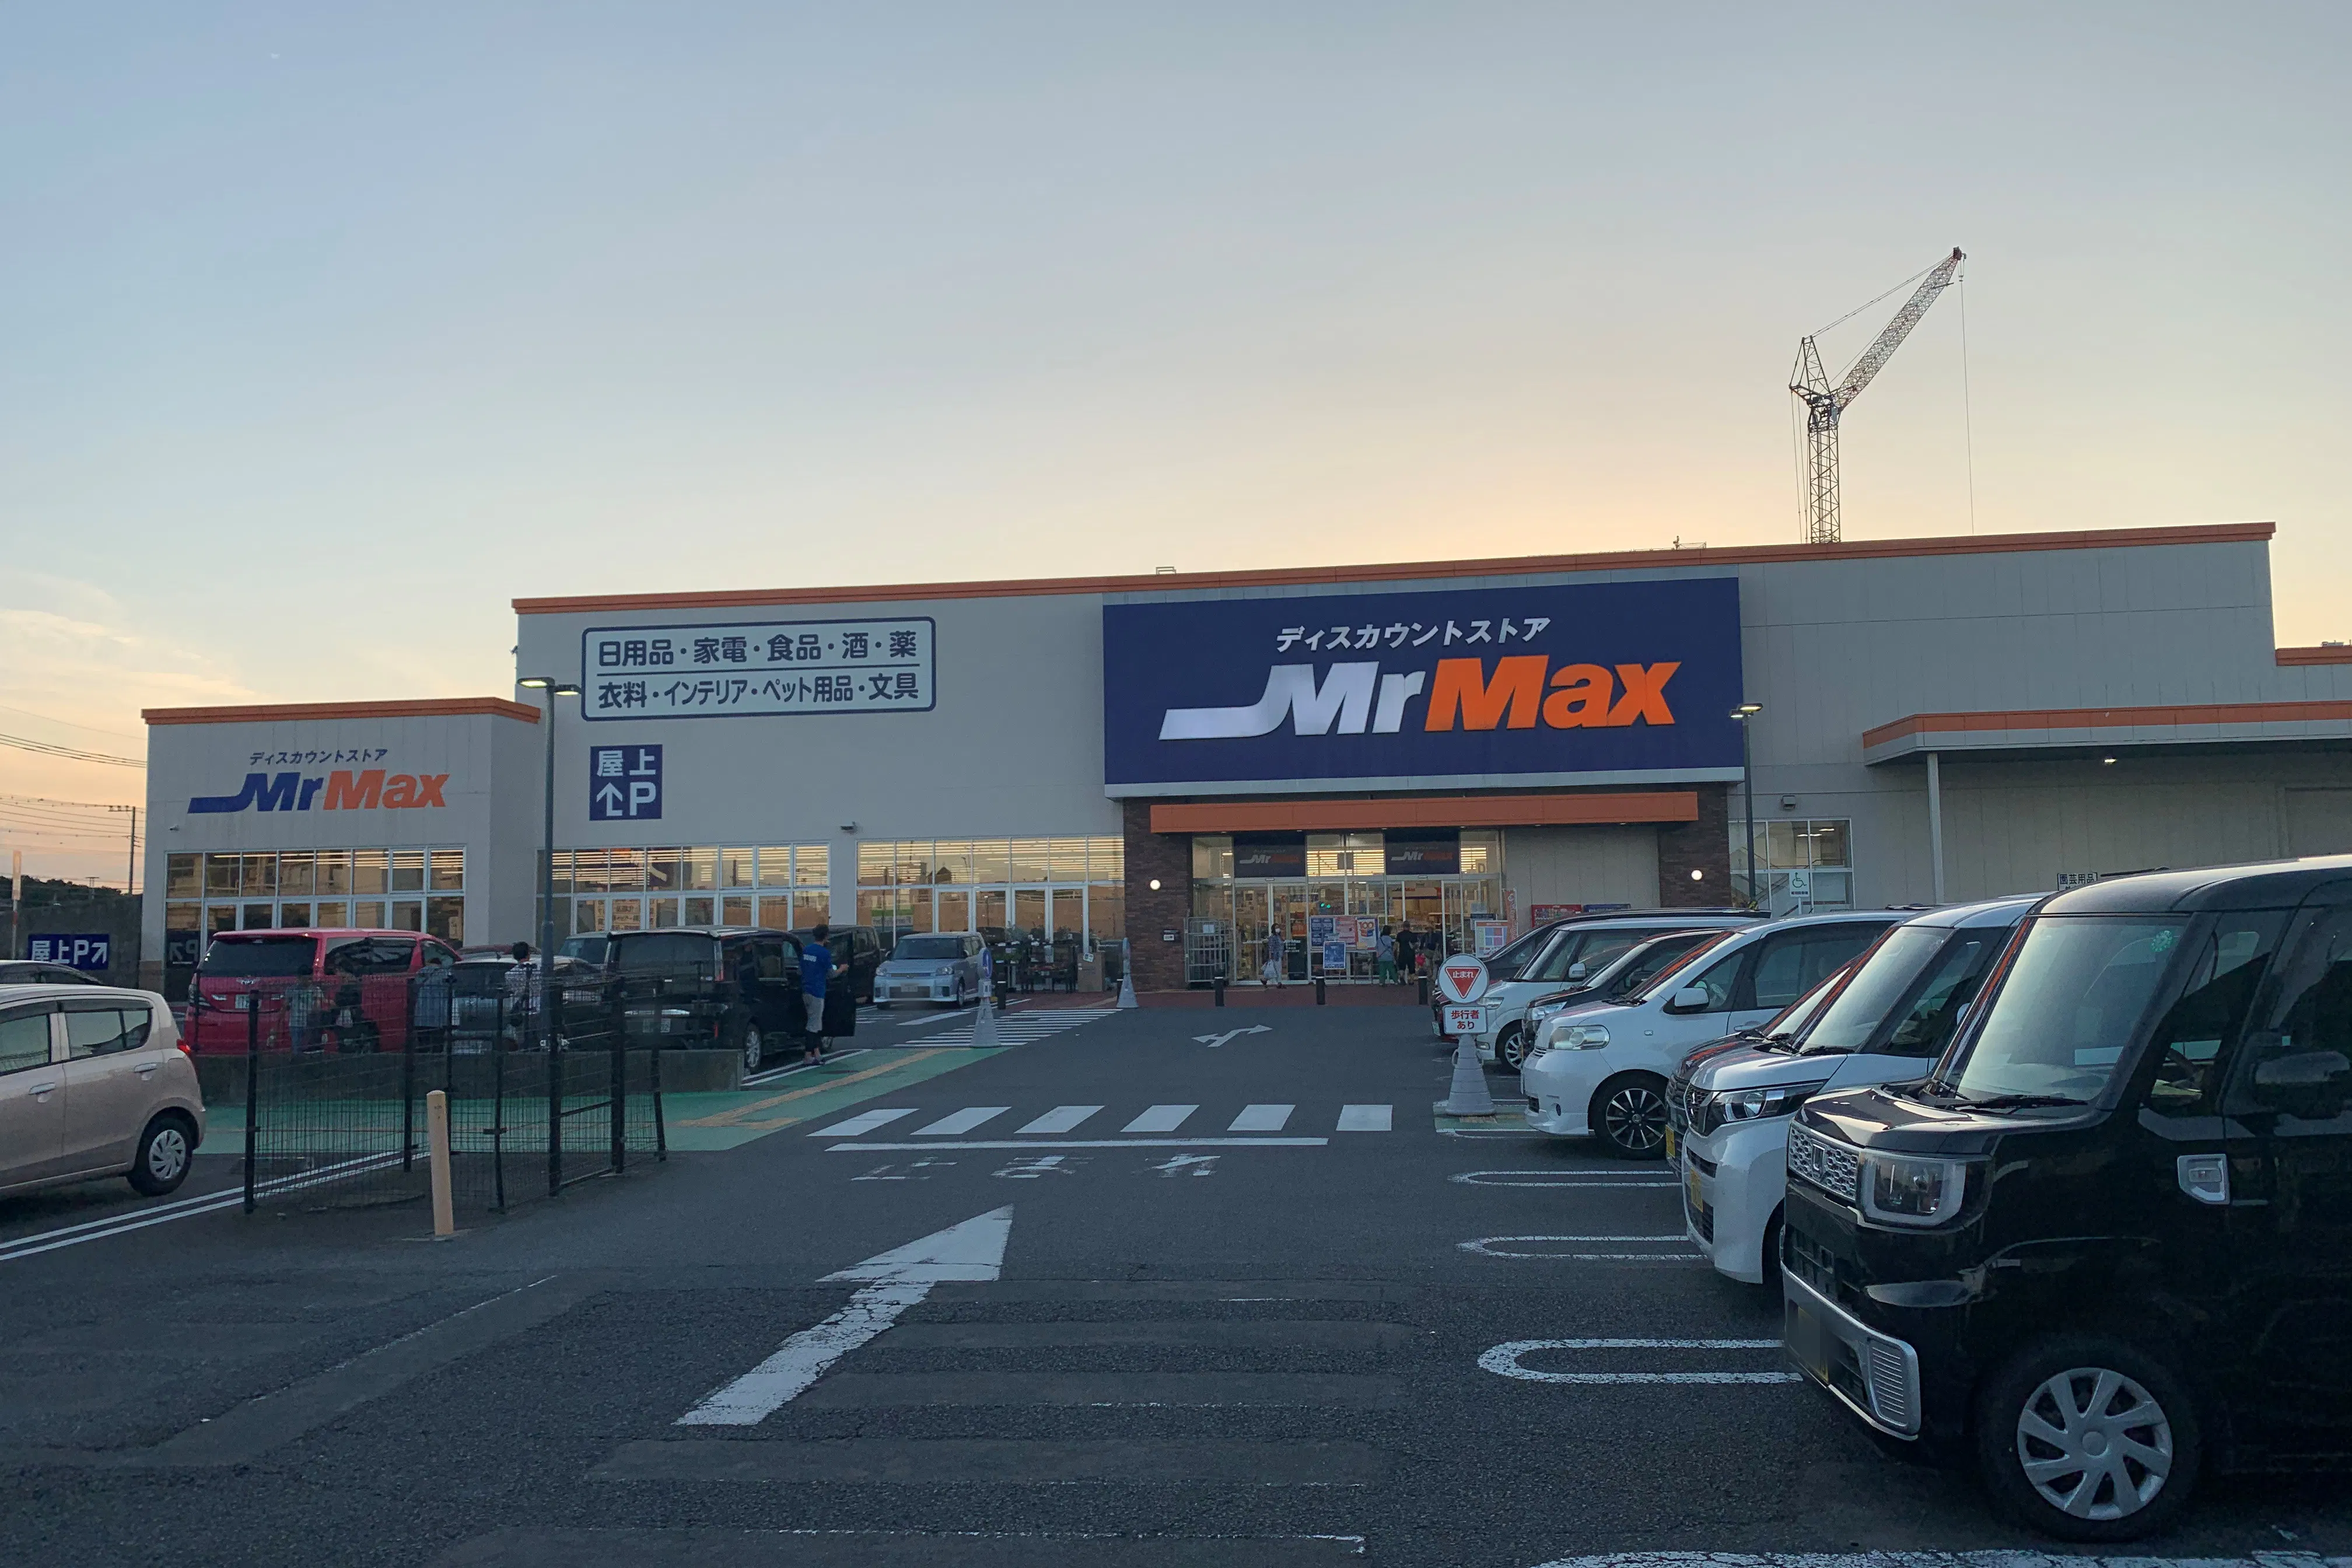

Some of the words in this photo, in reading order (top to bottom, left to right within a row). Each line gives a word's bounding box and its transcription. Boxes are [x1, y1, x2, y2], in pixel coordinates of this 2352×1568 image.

[1276, 617, 1551, 652] ディスカウントストア
[249, 748, 388, 765] ディスカウントストア
[597, 749, 656, 778] 屋上
[629, 781, 656, 816] P
[2059, 873, 2095, 884] 園芸用品
[1451, 1010, 1479, 1019] 歩行者
[1457, 1021, 1475, 1030] あり
